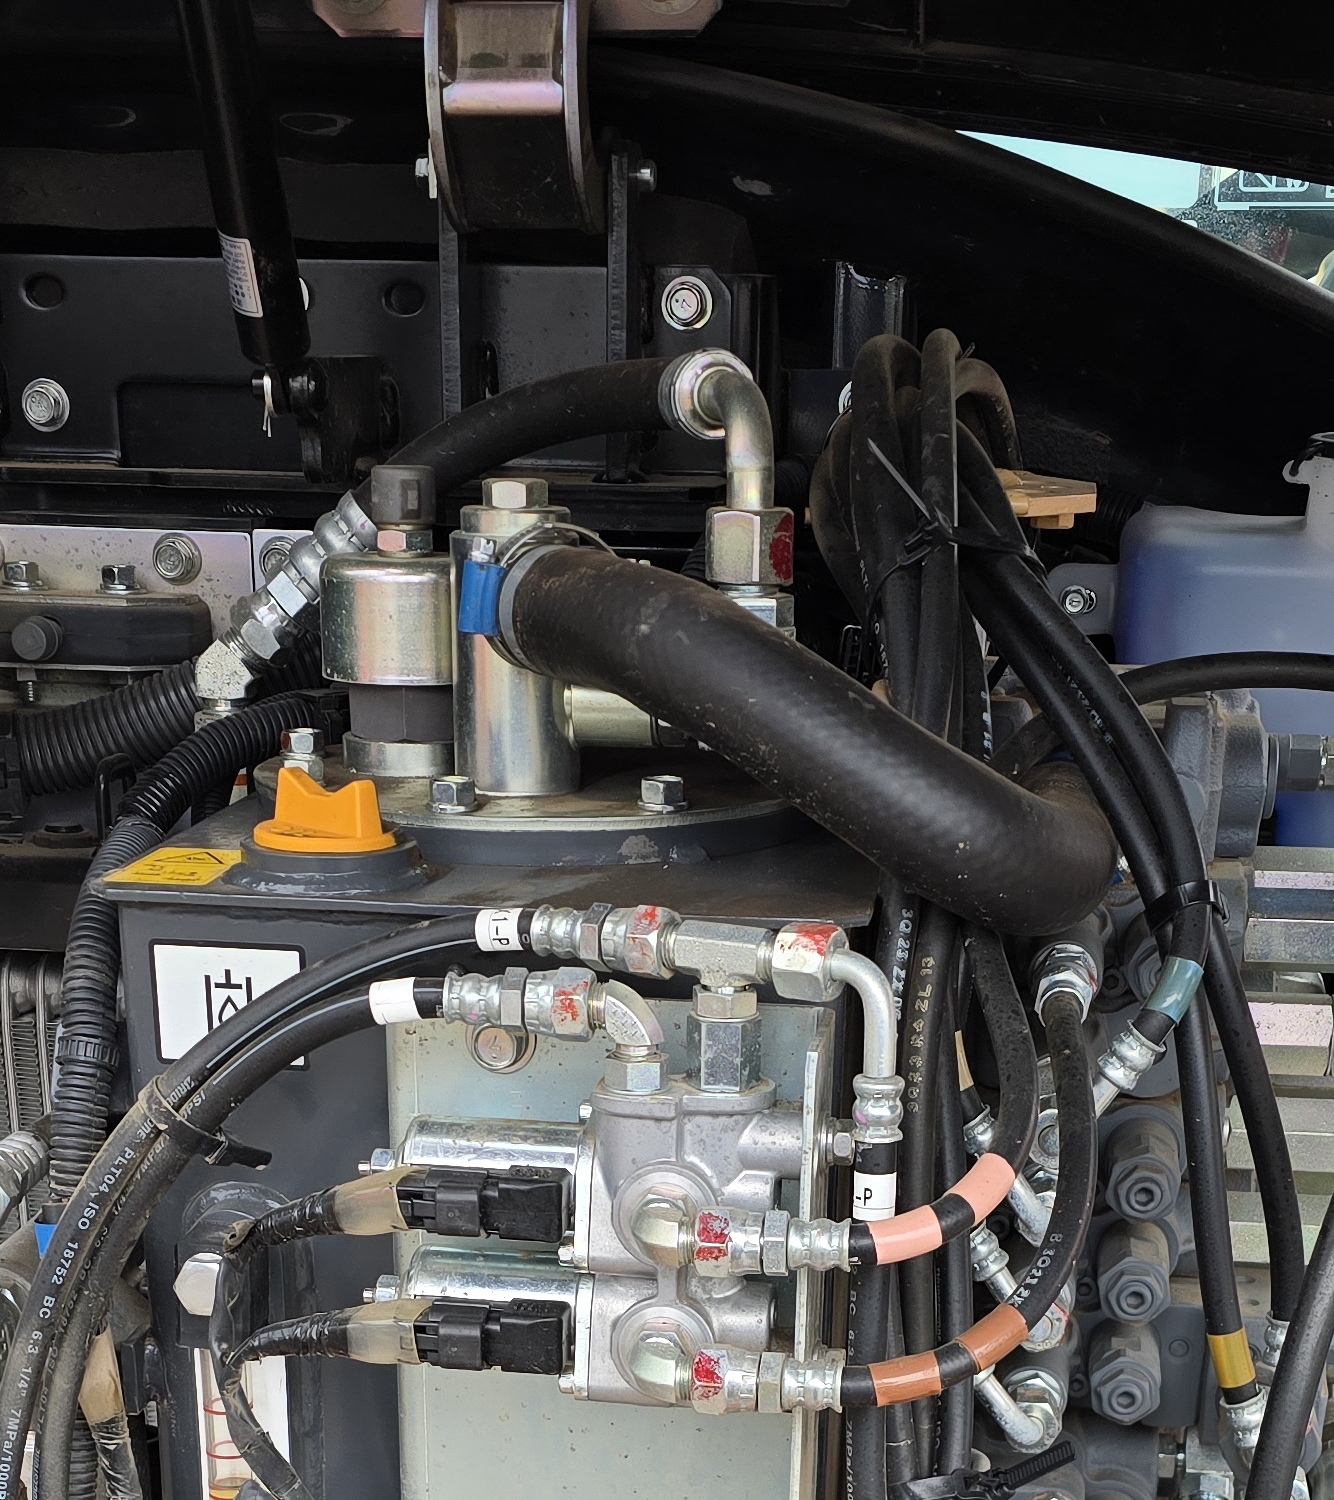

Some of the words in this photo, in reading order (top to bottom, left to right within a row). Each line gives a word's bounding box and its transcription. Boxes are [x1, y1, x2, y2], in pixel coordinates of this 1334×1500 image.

[97, 1146, 135, 1193] PLT04
[78, 1202, 100, 1230] ISO
[52, 1241, 79, 1286] 18752
[39, 1295, 56, 1319] BC
[27, 1330, 43, 1354] 6.3
